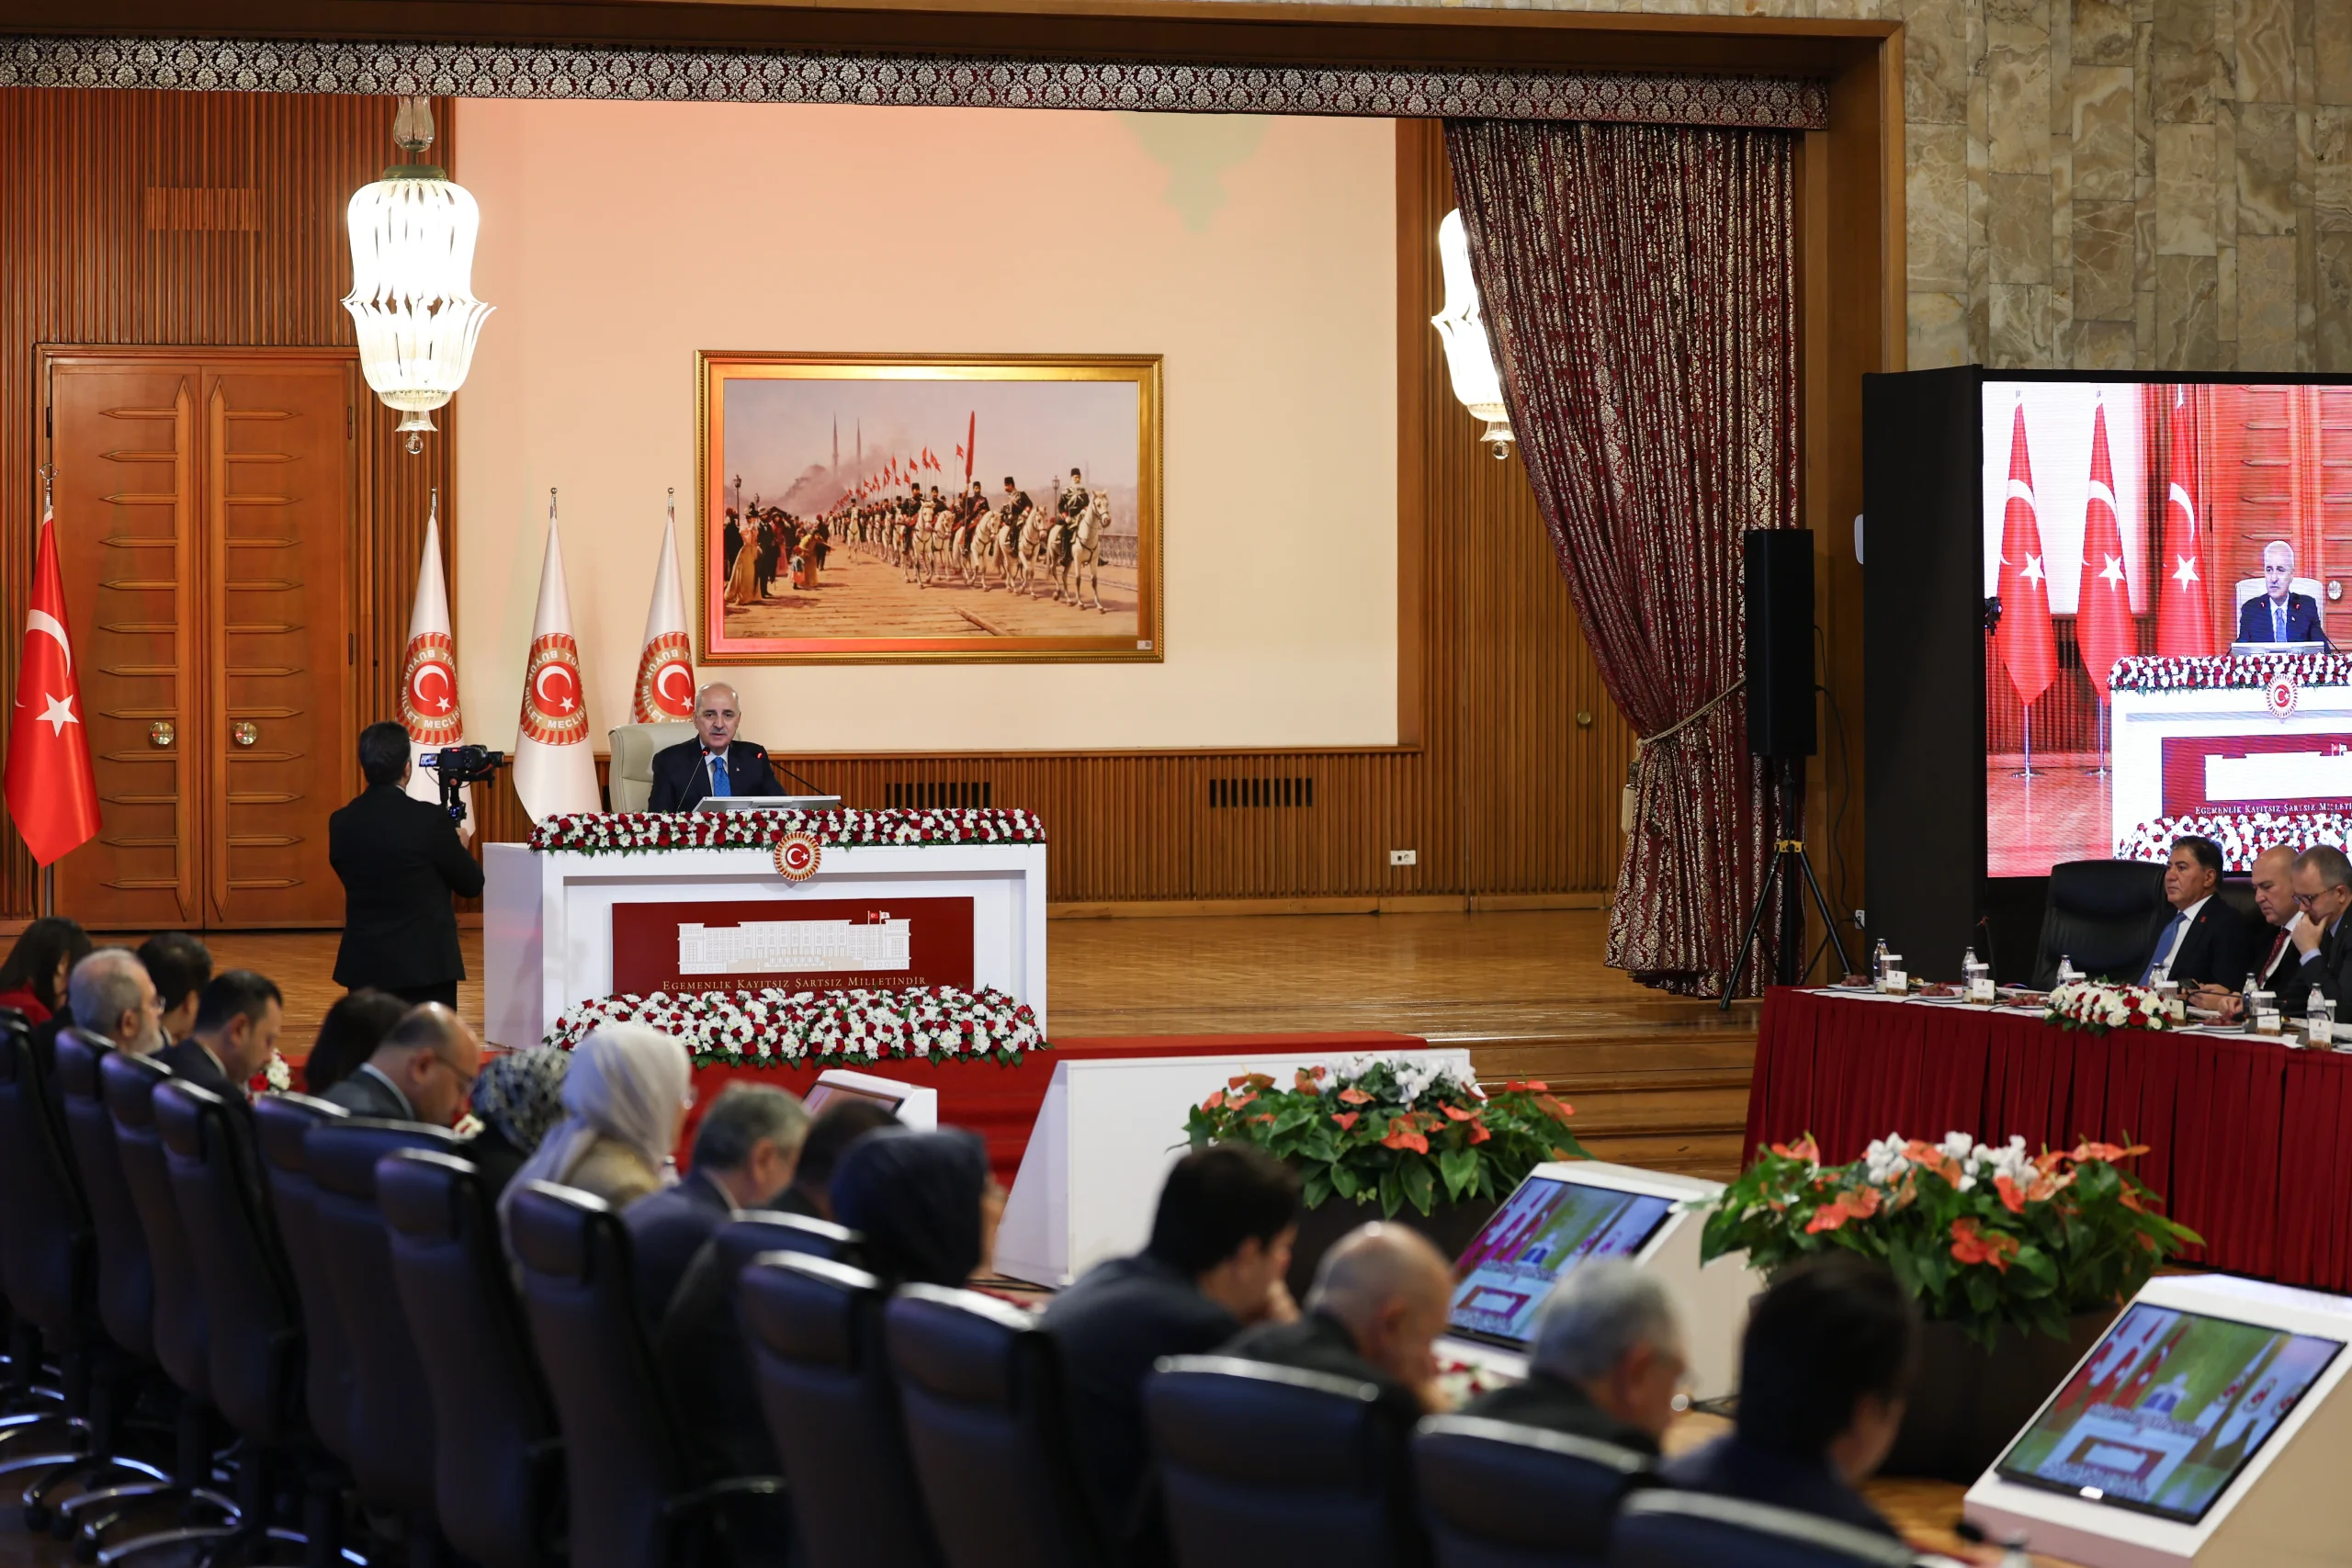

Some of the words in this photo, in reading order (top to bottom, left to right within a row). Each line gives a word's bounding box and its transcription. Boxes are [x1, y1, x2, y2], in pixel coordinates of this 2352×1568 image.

[645, 649, 679, 680] BÜYÜK
[642, 685, 665, 723] MİLLET
[662, 980, 731, 990] EGEMENLİK
[737, 978, 790, 989] KAYITSIZ
[795, 977, 842, 989] ŞARTSIZ
[848, 976, 926, 987] MİLLETİNDİR
